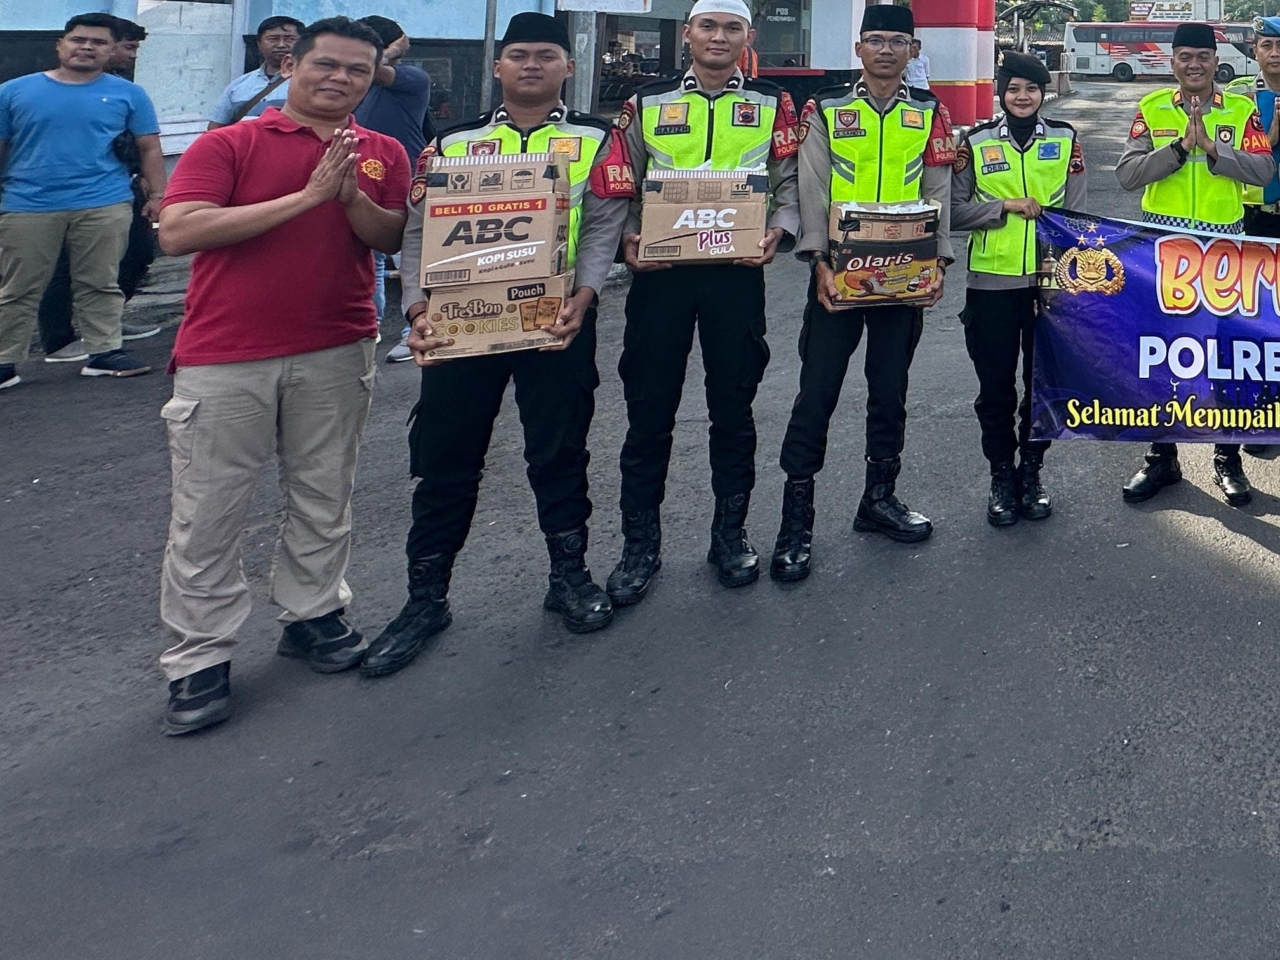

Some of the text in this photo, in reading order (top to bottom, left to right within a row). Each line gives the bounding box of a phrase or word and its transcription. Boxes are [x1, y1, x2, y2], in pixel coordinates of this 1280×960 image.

[435, 200, 542, 215] BELI 10 GRATIS 1
[672, 207, 738, 230] ABC
[442, 215, 533, 247] ABC
[698, 229, 732, 251] Plus
[477, 246, 537, 266] KOPI SUSU
[710, 245, 735, 255] GULA
[846, 252, 914, 271] Olaris
[511, 285, 544, 299] Pouch
[433, 317, 520, 338] COOKIES
[1066, 398, 1160, 428] Selamat
